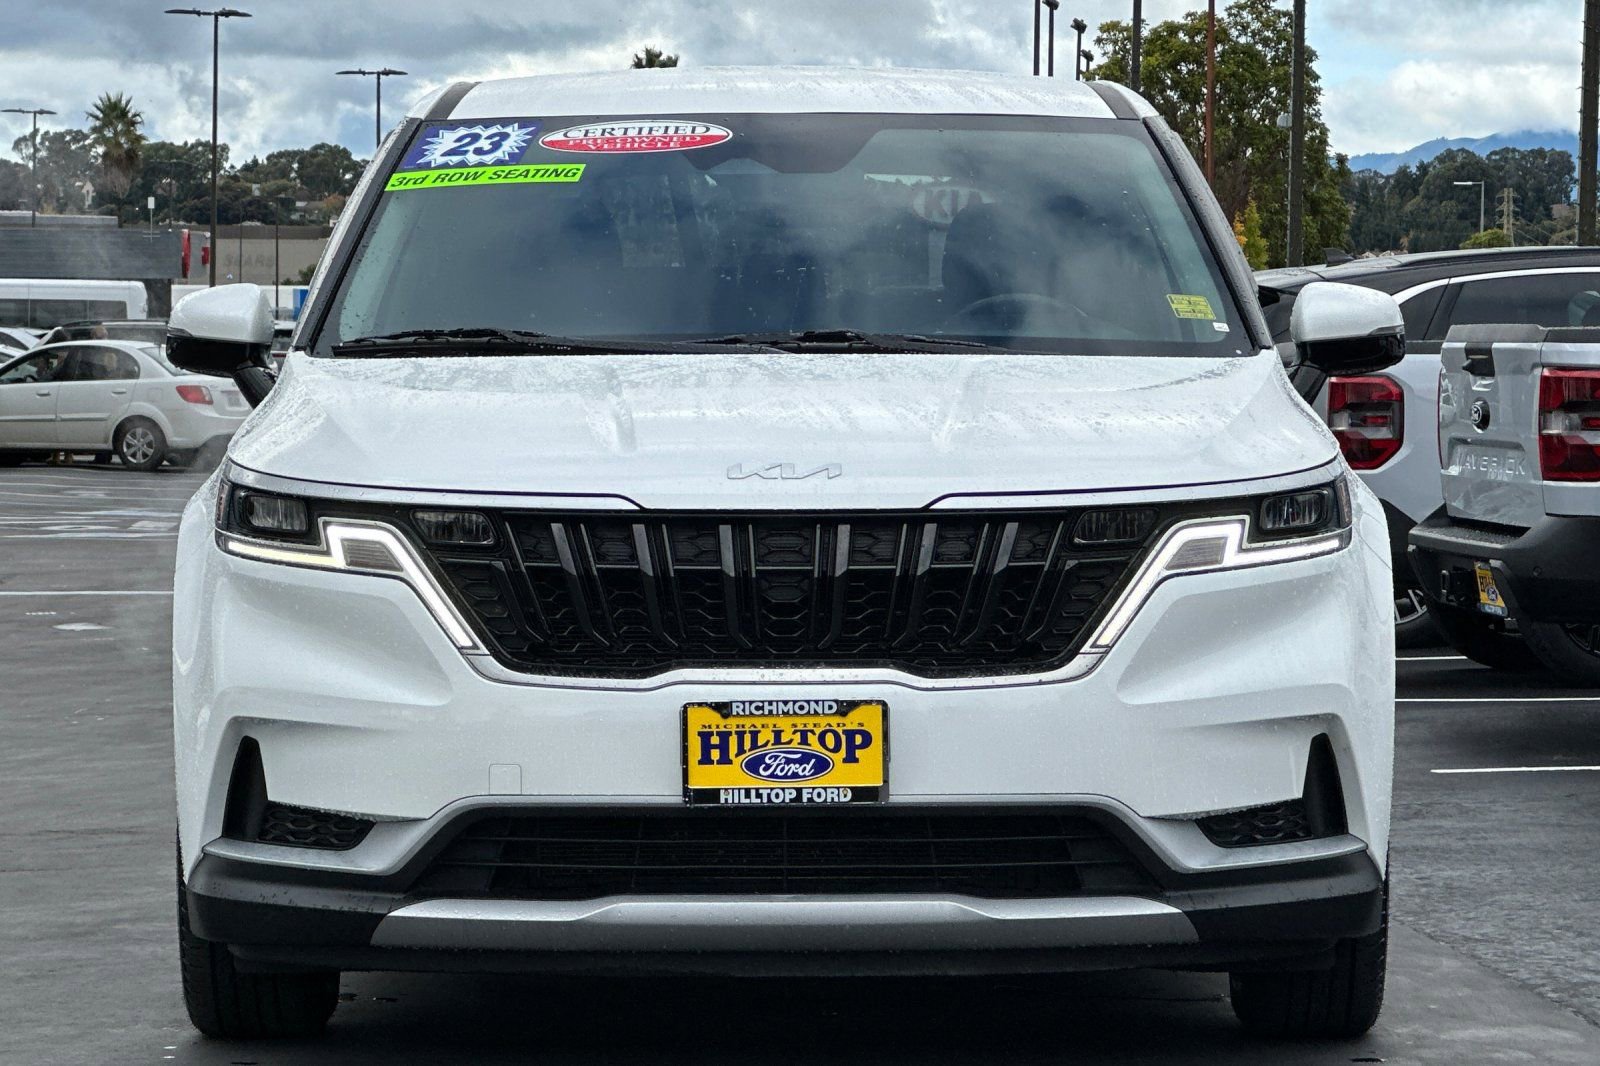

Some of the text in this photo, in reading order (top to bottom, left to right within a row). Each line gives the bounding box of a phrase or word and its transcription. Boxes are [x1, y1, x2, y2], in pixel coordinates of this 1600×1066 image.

[562, 125, 711, 139] CERTIFIED
[567, 135, 702, 146] PRE-OWNED
[439, 131, 512, 157] 23
[584, 141, 682, 150] VEHICLE
[390, 166, 582, 188] 3rd ROW SEATING
[726, 462, 842, 480] KIA
[731, 701, 838, 716] RICHMOND
[791, 721, 866, 729] STEAD'S
[697, 728, 873, 766] HILLTOP
[758, 752, 816, 777] Ford
[719, 787, 853, 804] HILLTOP FORD
